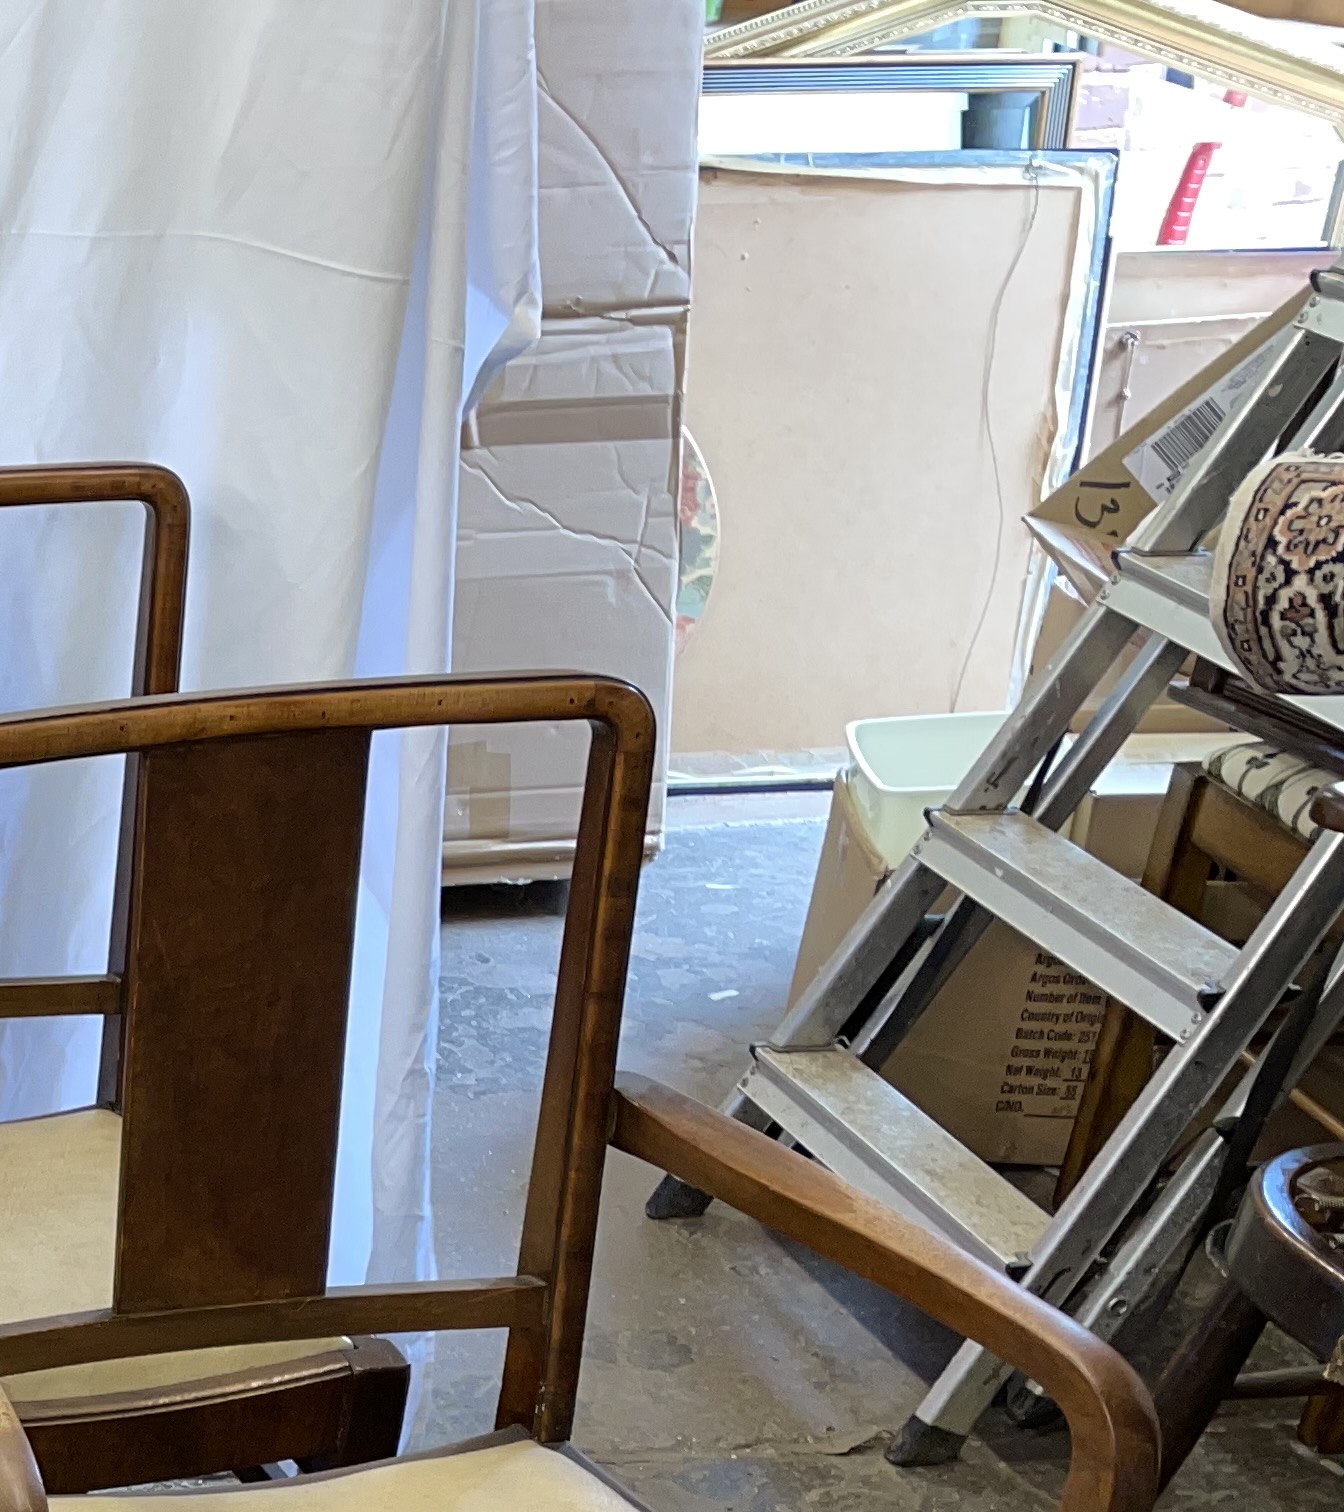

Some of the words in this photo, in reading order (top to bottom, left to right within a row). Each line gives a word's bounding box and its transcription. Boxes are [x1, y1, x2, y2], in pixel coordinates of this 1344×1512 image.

[1030, 971, 1061, 988] Argos
[1025, 989, 1066, 1004] Number
[1066, 992, 1079, 1005] of
[1020, 1008, 1061, 1025] Country
[1063, 1011, 1075, 1023] of
[1016, 1027, 1044, 1040] Batch
[1011, 1045, 1041, 1059] Gross
[1005, 1064, 1023, 1077] Net
[1000, 1081, 1034, 1094] Carton
